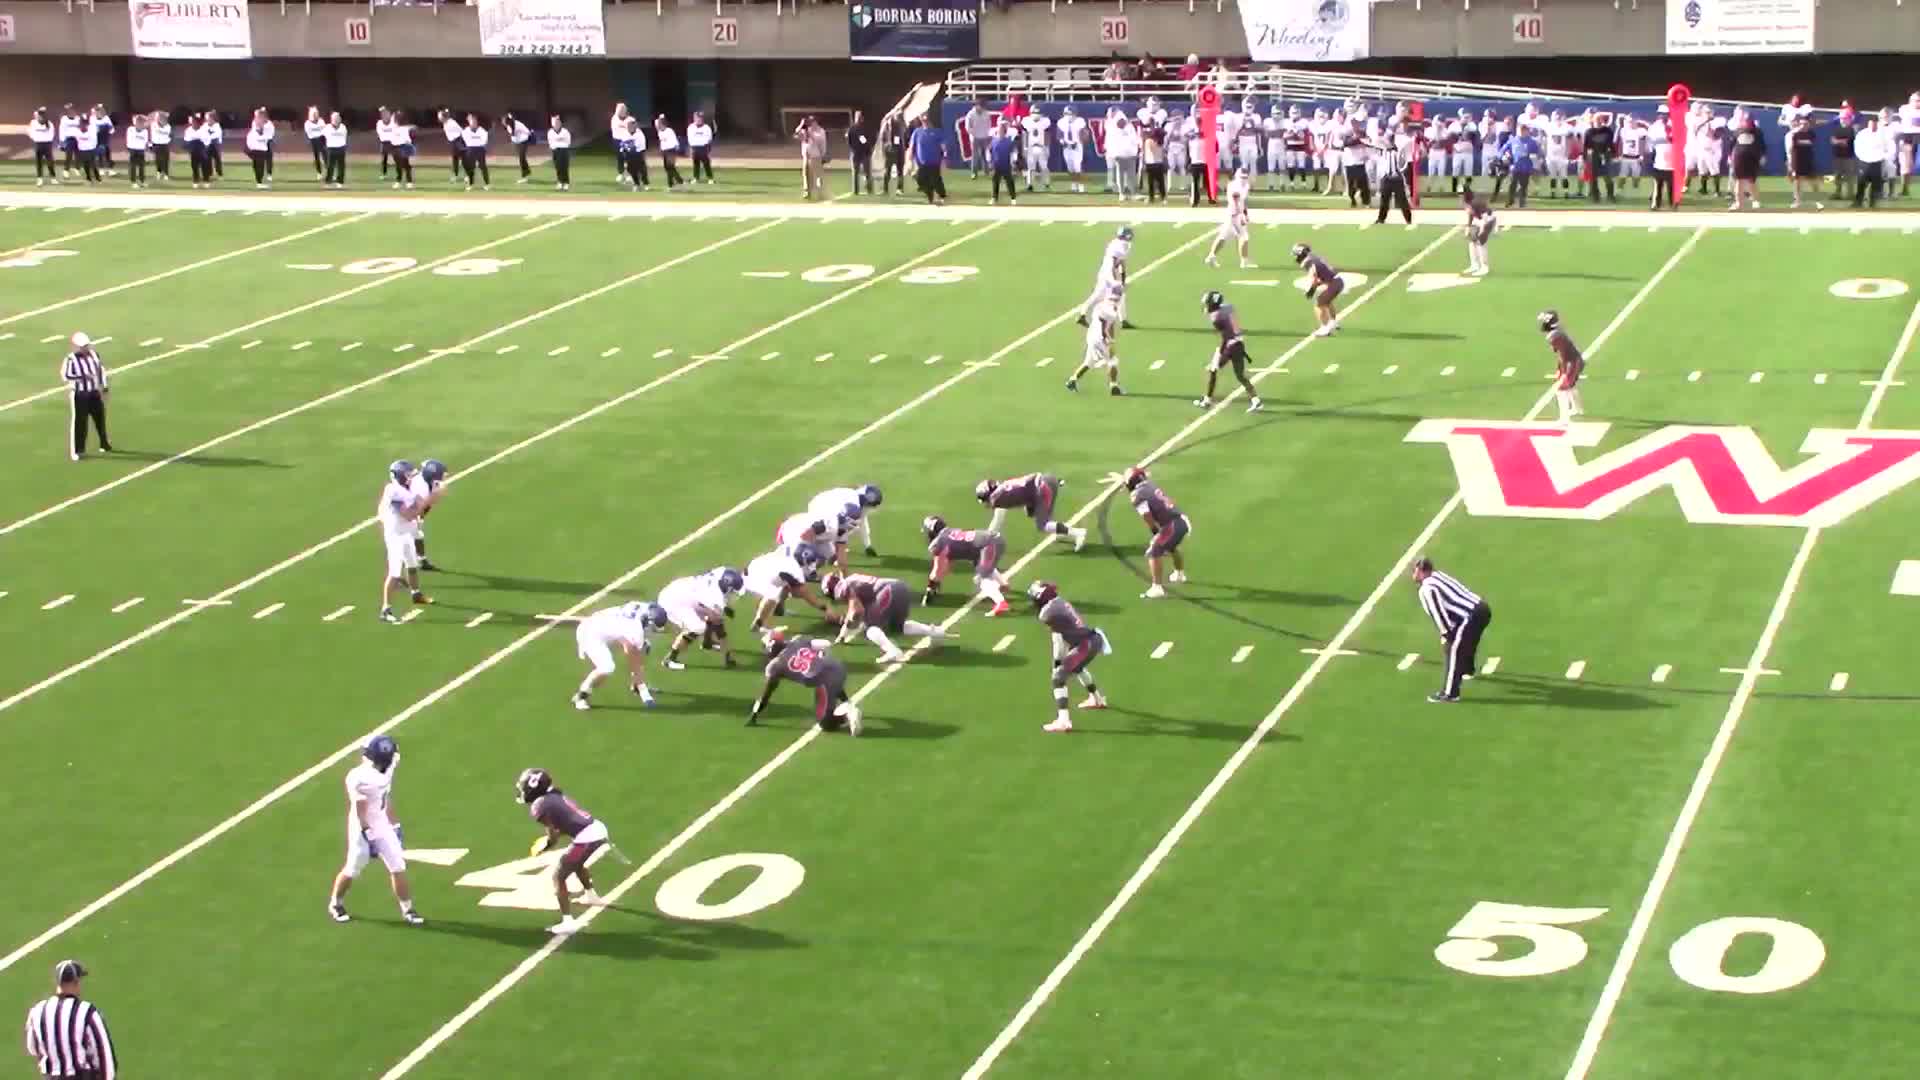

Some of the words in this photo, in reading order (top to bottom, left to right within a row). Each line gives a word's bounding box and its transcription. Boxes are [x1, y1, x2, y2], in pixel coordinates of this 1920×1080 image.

[166, 3, 241, 18] LIBERTY
[874, 8, 922, 24] BORDAS
[927, 8, 976, 25] BORDAS
[349, 22, 367, 41] 10
[714, 23, 737, 41] 20
[1103, 21, 1127, 41] 30
[1515, 19, 1540, 38] 40
[1402, 418, 1920, 528] W
[1434, 900, 1826, 993] 50
